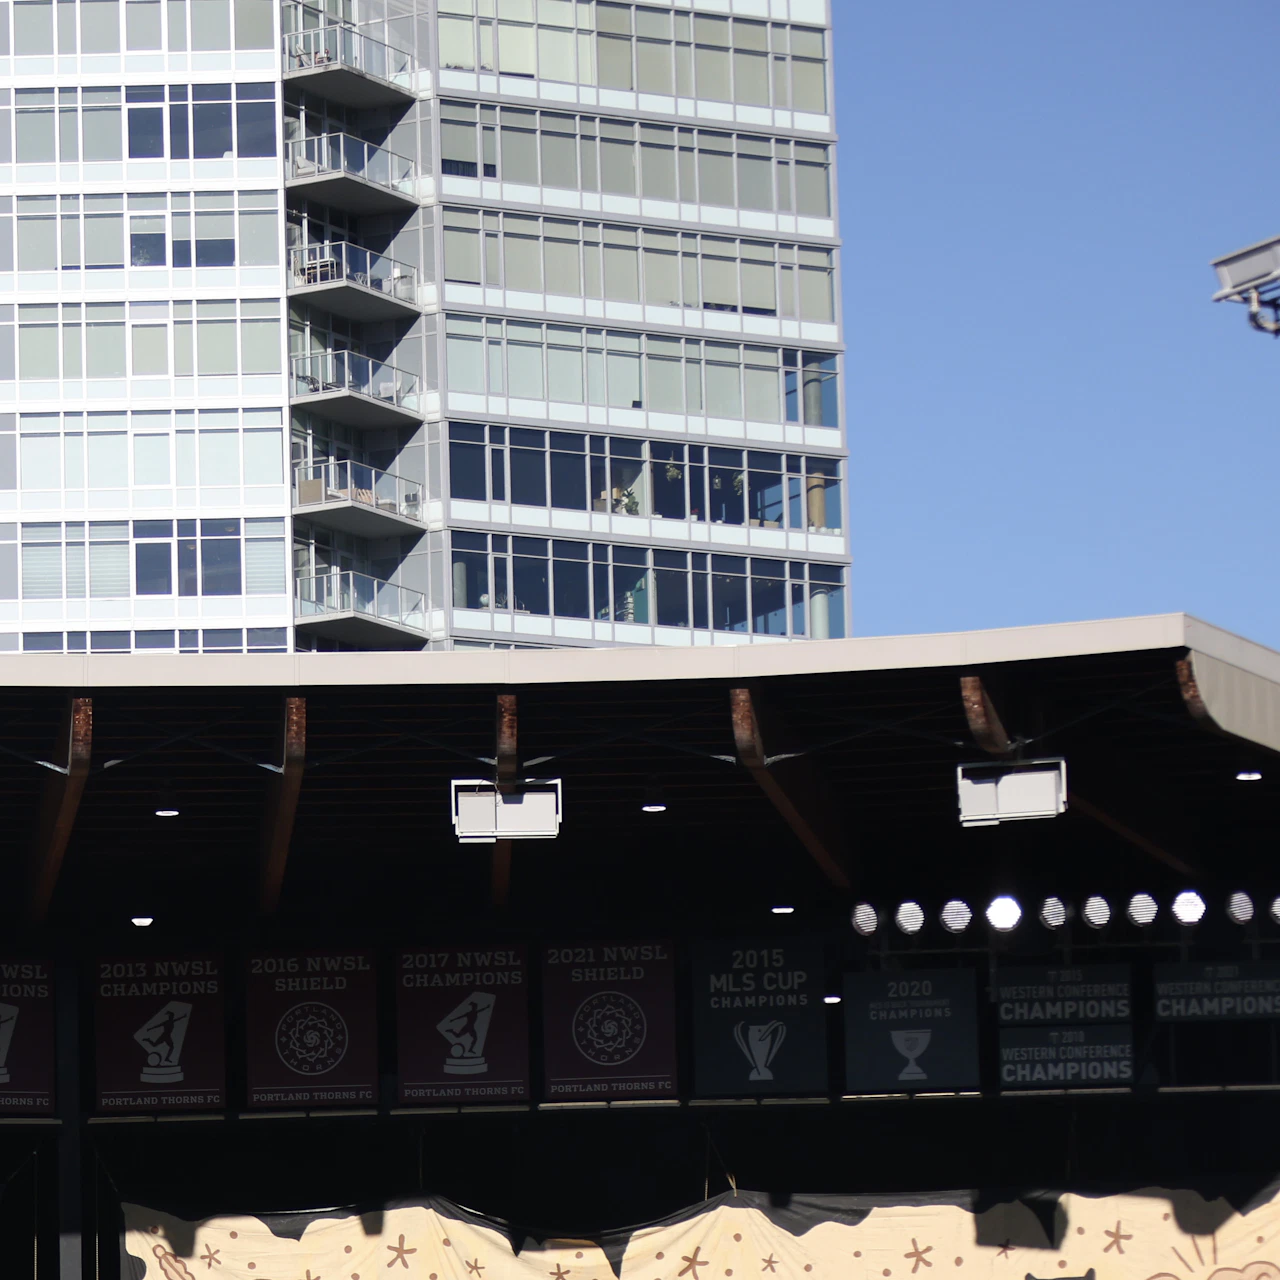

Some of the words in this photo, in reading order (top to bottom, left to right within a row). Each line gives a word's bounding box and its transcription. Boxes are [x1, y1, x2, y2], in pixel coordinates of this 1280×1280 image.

[402, 953, 450, 969] 2017
[457, 950, 521, 967] NWSL
[547, 947, 596, 964] 2021
[603, 945, 667, 962] NWSL
[732, 949, 784, 969] 2015
[100, 963, 147, 979] 2013
[154, 960, 217, 978] NWSL
[251, 957, 299, 974] 2016
[306, 956, 370, 973] NWSL
[402, 970, 522, 988] CHAMPIONS
[571, 966, 645, 983] SHIELD
[709, 973, 754, 993] MLS
[762, 971, 807, 992] CUP
[100, 980, 218, 997] CHAMPIONS
[275, 976, 346, 992] SHIELD
[887, 980, 932, 998] 2020
[999, 985, 1054, 999] WESTERN
[1057, 983, 1129, 998] CONFERENCE
[1157, 982, 1211, 996] WESTERN
[710, 994, 808, 1009] CHAMPIONS
[1000, 1000, 1130, 1020] CHAMPIONS
[869, 1007, 952, 1020] CHAMPIONS
[1001, 1046, 1057, 1061] WESTERN
[1059, 1044, 1132, 1059] CONFERENCE
[1002, 1061, 1132, 1082] CHAMPIONS
[252, 1092, 310, 1102] PORTLAND
[313, 1091, 356, 1101] THORNS
[359, 1090, 372, 1099] FC
[404, 1088, 461, 1098] PORTLAND
[464, 1087, 508, 1097] THORNS
[511, 1086, 524, 1095] FC
[550, 1083, 608, 1094] PORTLAND
[611, 1082, 654, 1092] THORNS
[657, 1081, 672, 1090] FC
[36, 1097, 49, 1106] FC
[101, 1096, 158, 1106] PORTLAND
[161, 1095, 205, 1105] THORNS
[207, 1095, 220, 1104] FC
